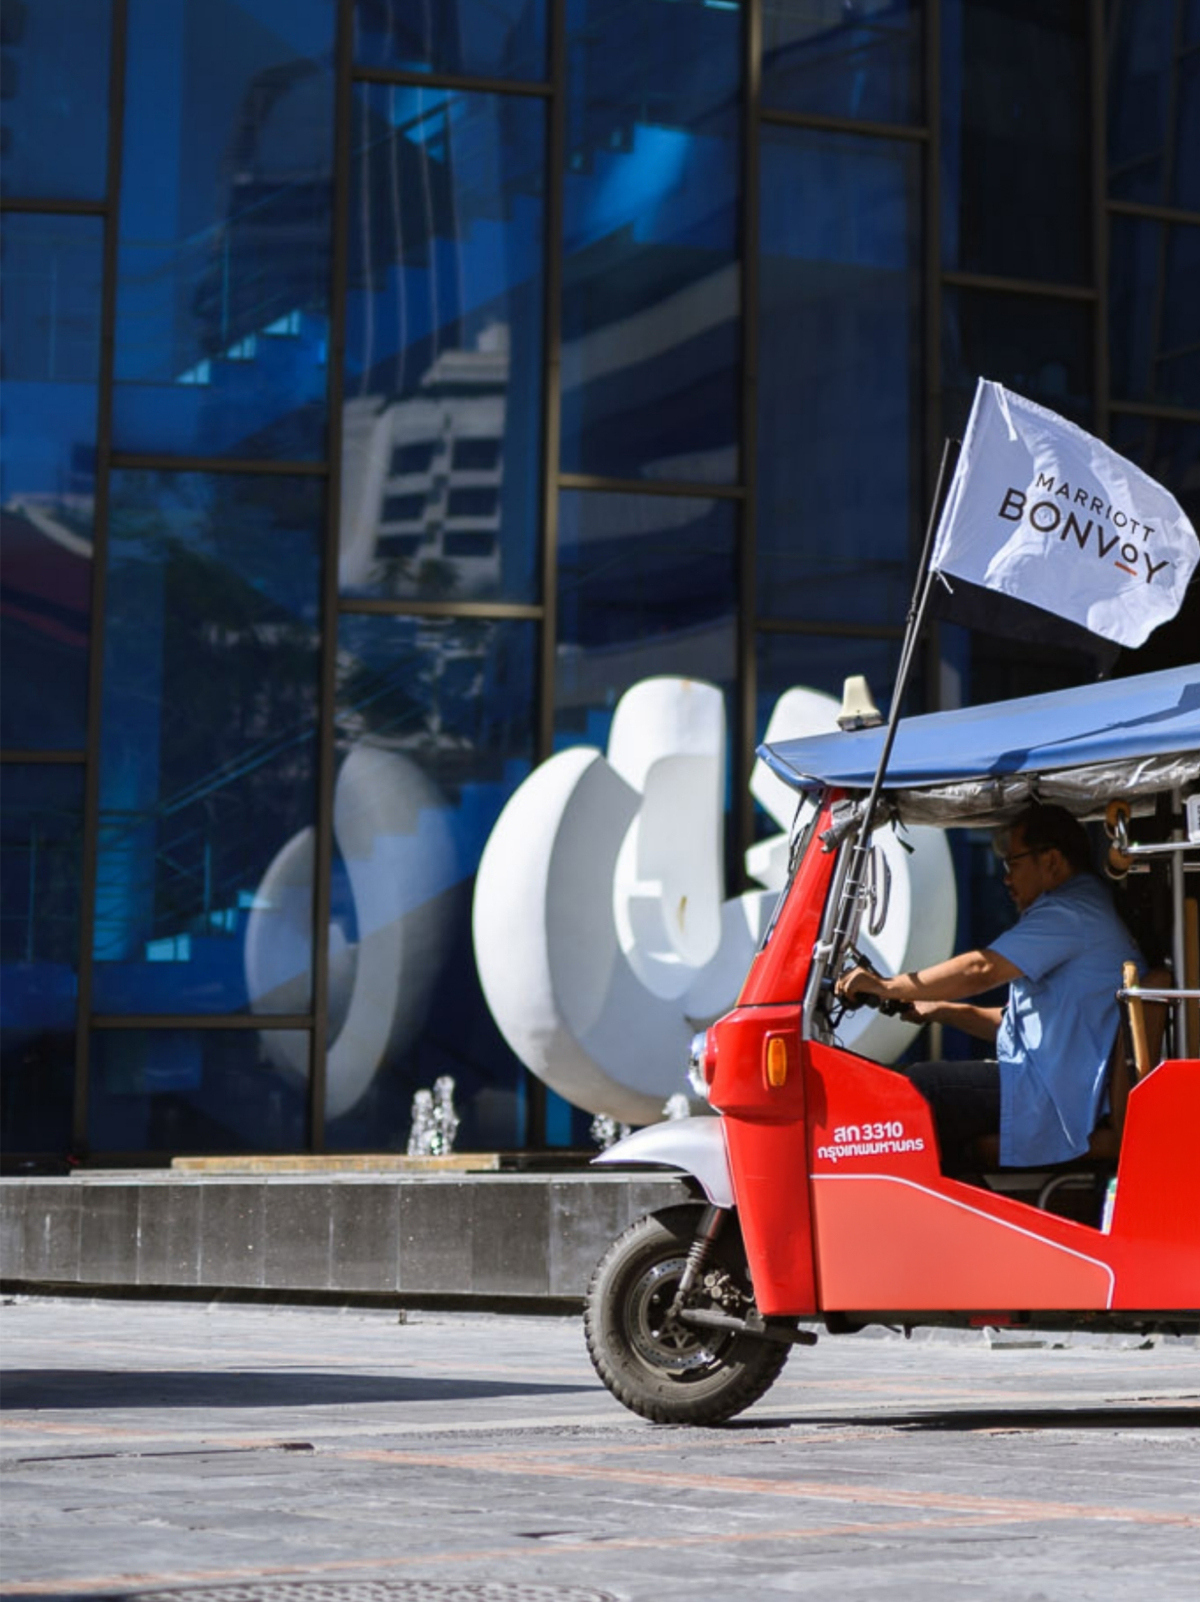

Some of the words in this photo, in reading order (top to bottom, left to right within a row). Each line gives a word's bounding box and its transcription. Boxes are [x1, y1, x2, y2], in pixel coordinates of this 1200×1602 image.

[1035, 472, 1155, 542] MARRIOTT
[998, 487, 1170, 584] BONVOY
[817, 1138, 925, 1163] กรุงเทพมหานคร
[862, 1121, 904, 1141] 3310
